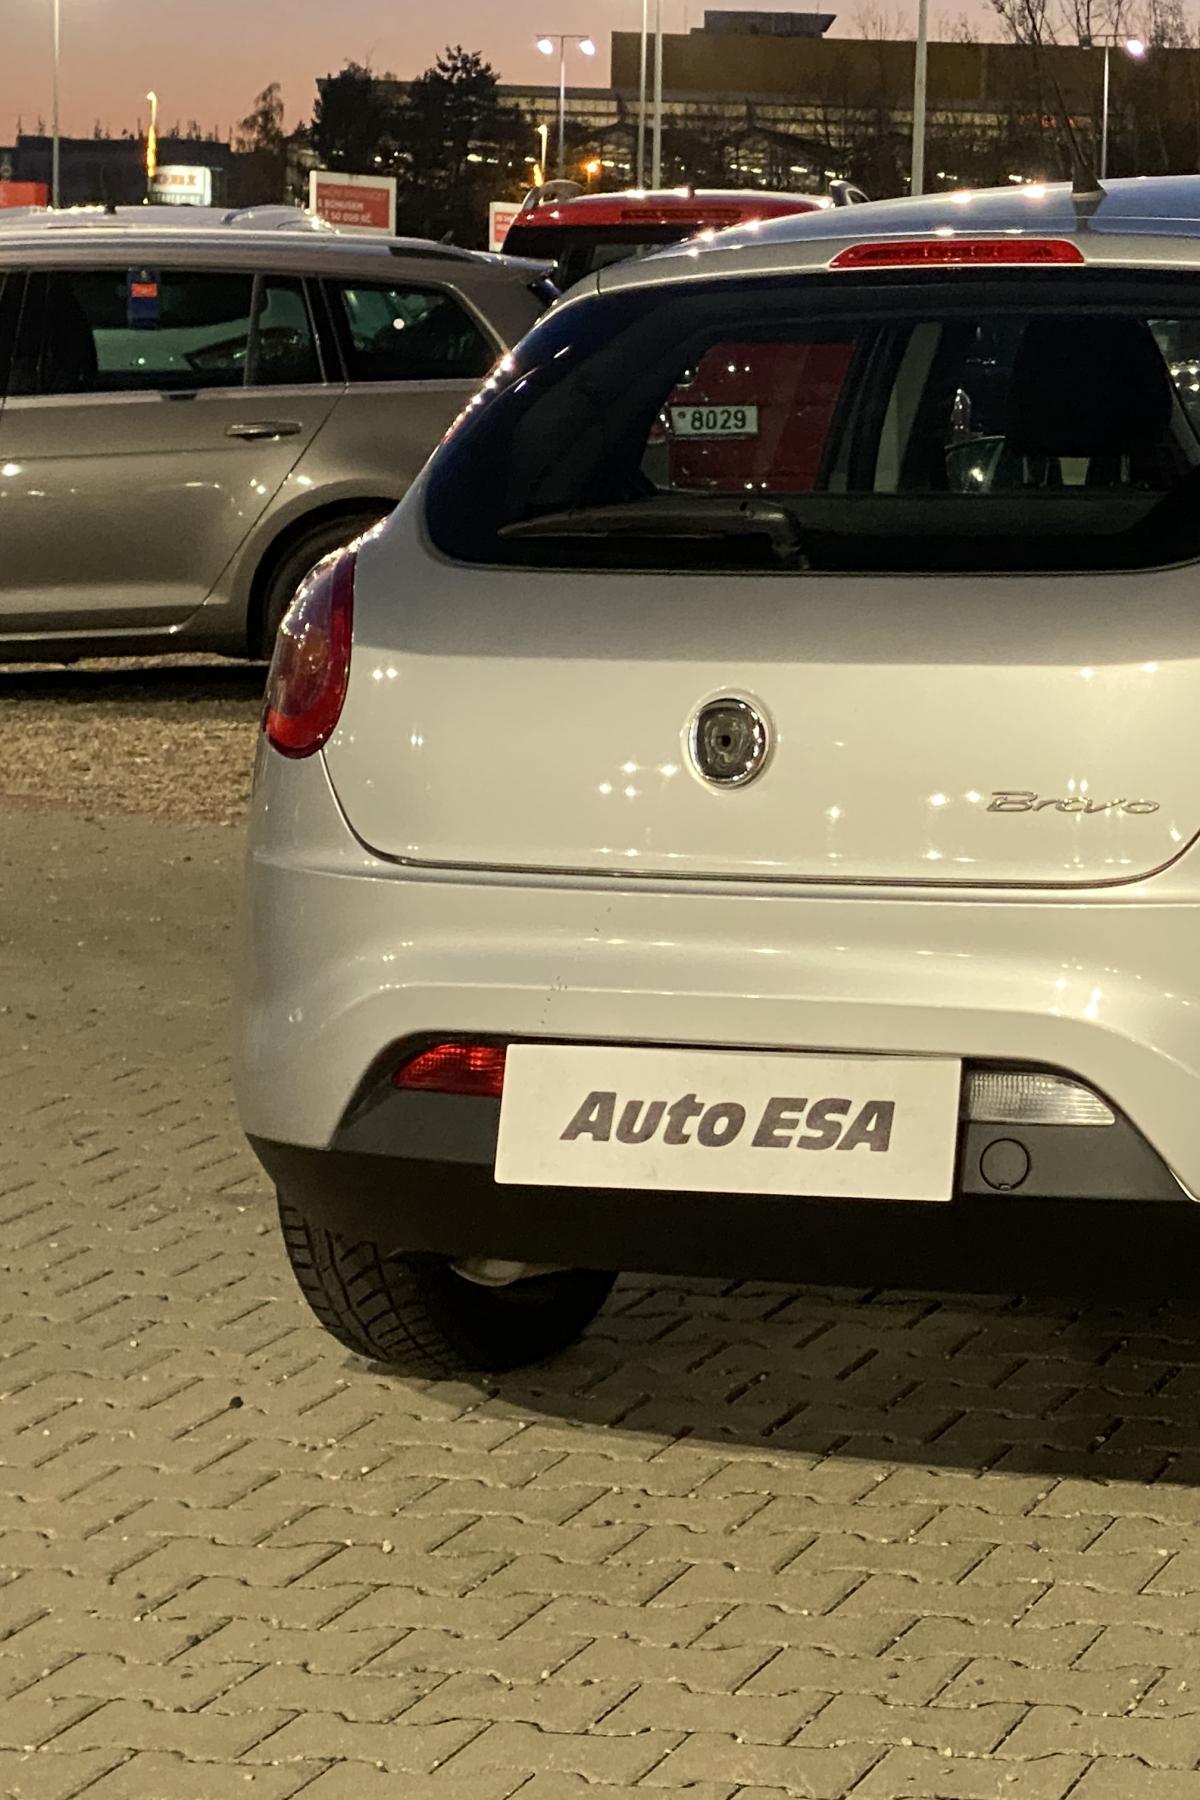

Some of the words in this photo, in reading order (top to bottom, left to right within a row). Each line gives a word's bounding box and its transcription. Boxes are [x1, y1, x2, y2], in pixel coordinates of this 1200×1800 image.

[691, 409, 747, 431] 8029
[986, 791, 1160, 814] Bravo
[560, 1091, 747, 1148] Auto
[751, 1097, 896, 1152] ESA
